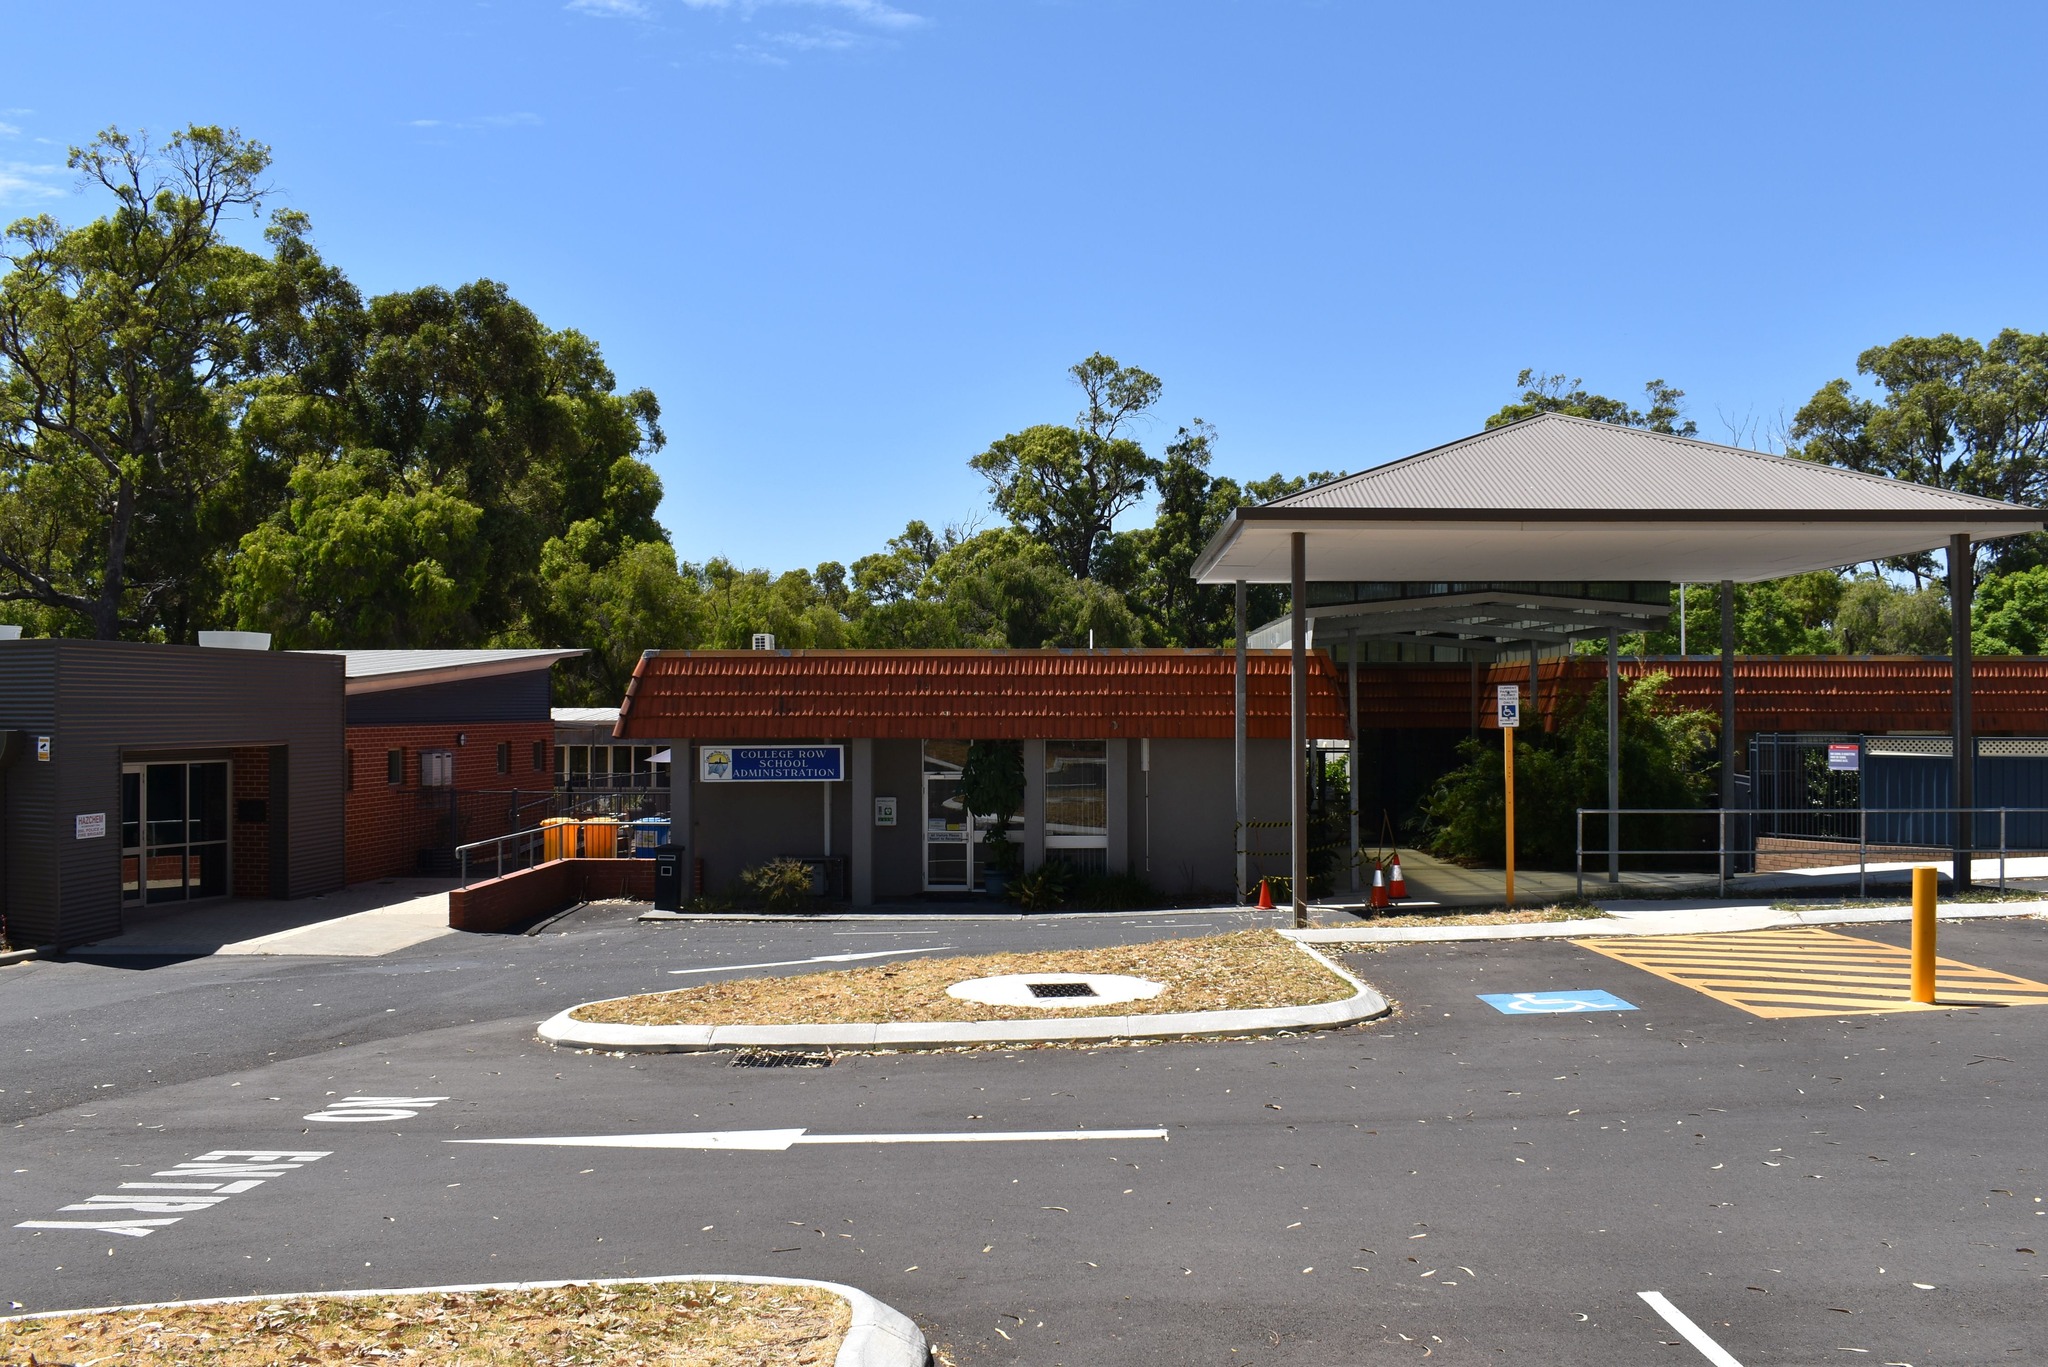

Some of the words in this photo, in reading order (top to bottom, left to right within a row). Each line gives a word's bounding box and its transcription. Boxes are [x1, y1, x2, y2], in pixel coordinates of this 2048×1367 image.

[740, 750, 795, 759] COLLEGE
[799, 750, 827, 758] ROW
[759, 759, 809, 768] SCHOOL
[732, 768, 835, 777] ADMINISTRATION
[78, 815, 104, 825] HAZCHEM
[303, 1096, 450, 1122] NO
[13, 1151, 334, 1237] ENTRY
